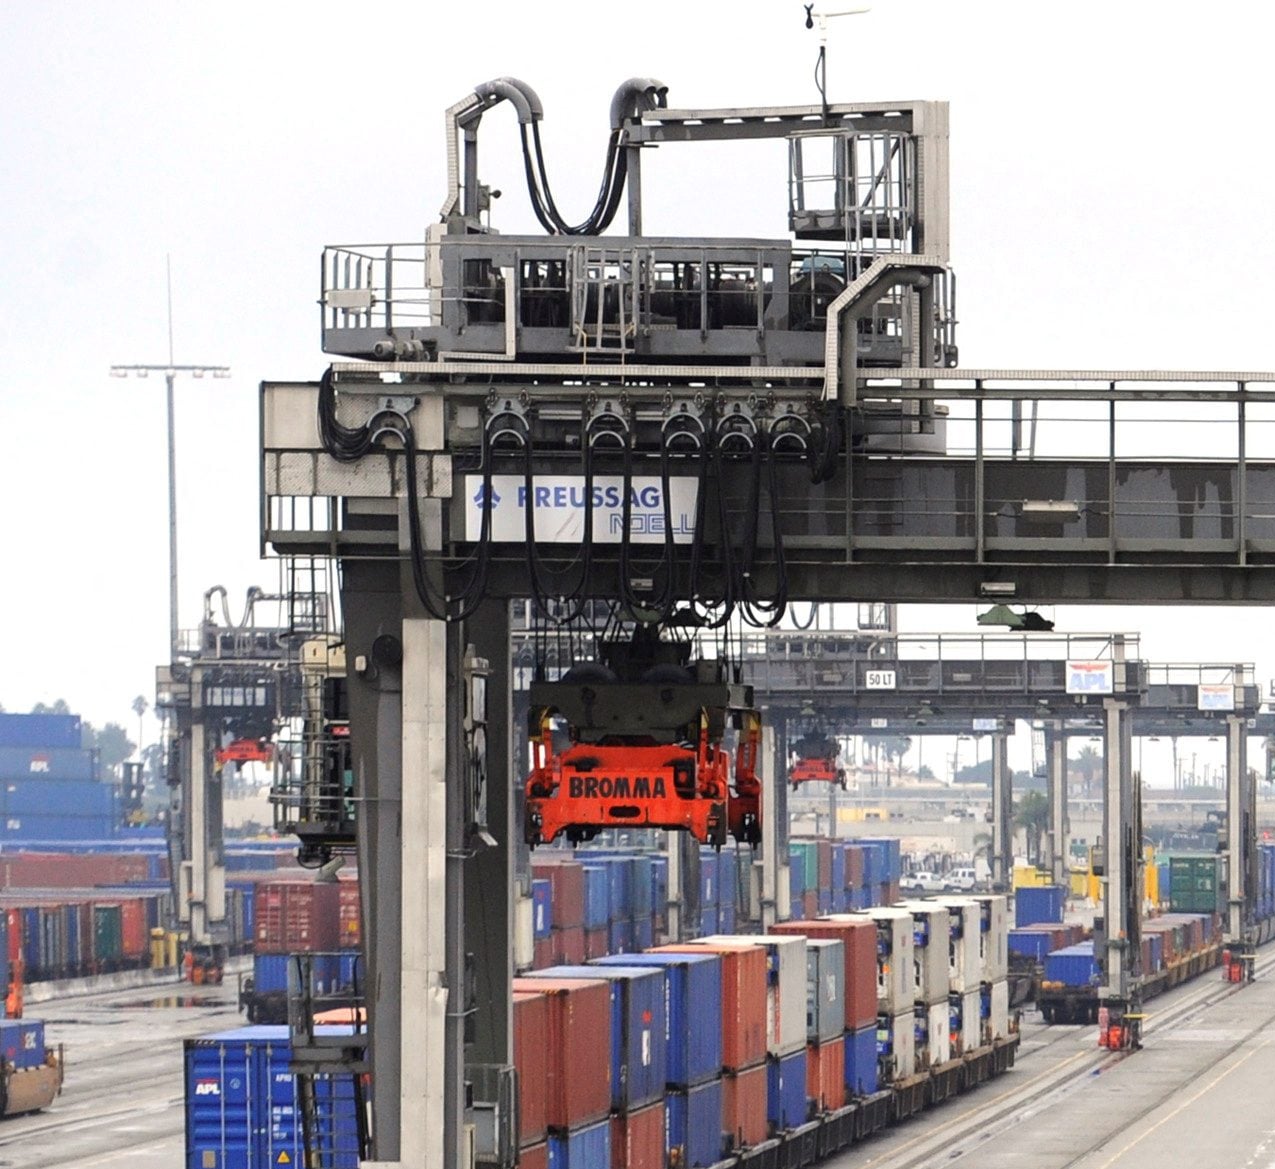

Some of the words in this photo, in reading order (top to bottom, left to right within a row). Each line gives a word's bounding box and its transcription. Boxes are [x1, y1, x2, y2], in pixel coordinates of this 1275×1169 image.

[868, 673, 881, 686] 50
[883, 673, 892, 686] LT
[1068, 672, 1111, 692] APL
[568, 776, 667, 799] BROMMA
[195, 1084, 221, 1095] APL
